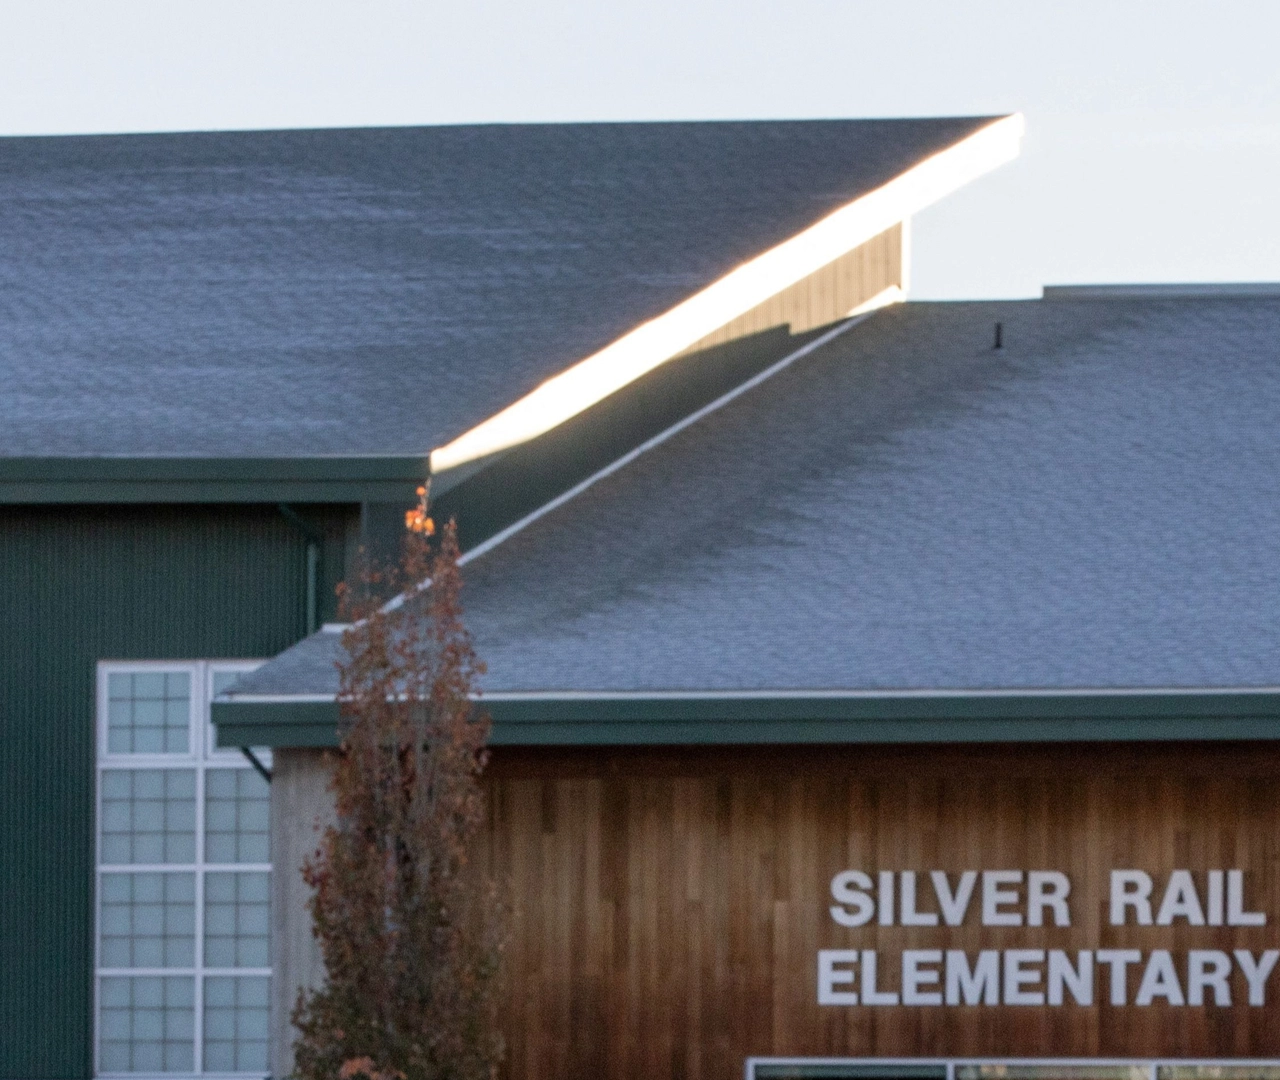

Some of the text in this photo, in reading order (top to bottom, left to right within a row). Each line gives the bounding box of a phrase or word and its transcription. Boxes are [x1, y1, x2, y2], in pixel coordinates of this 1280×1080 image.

[829, 869, 1267, 927] SILVER RAIL
[817, 949, 1280, 1007] ELEMENTARY
